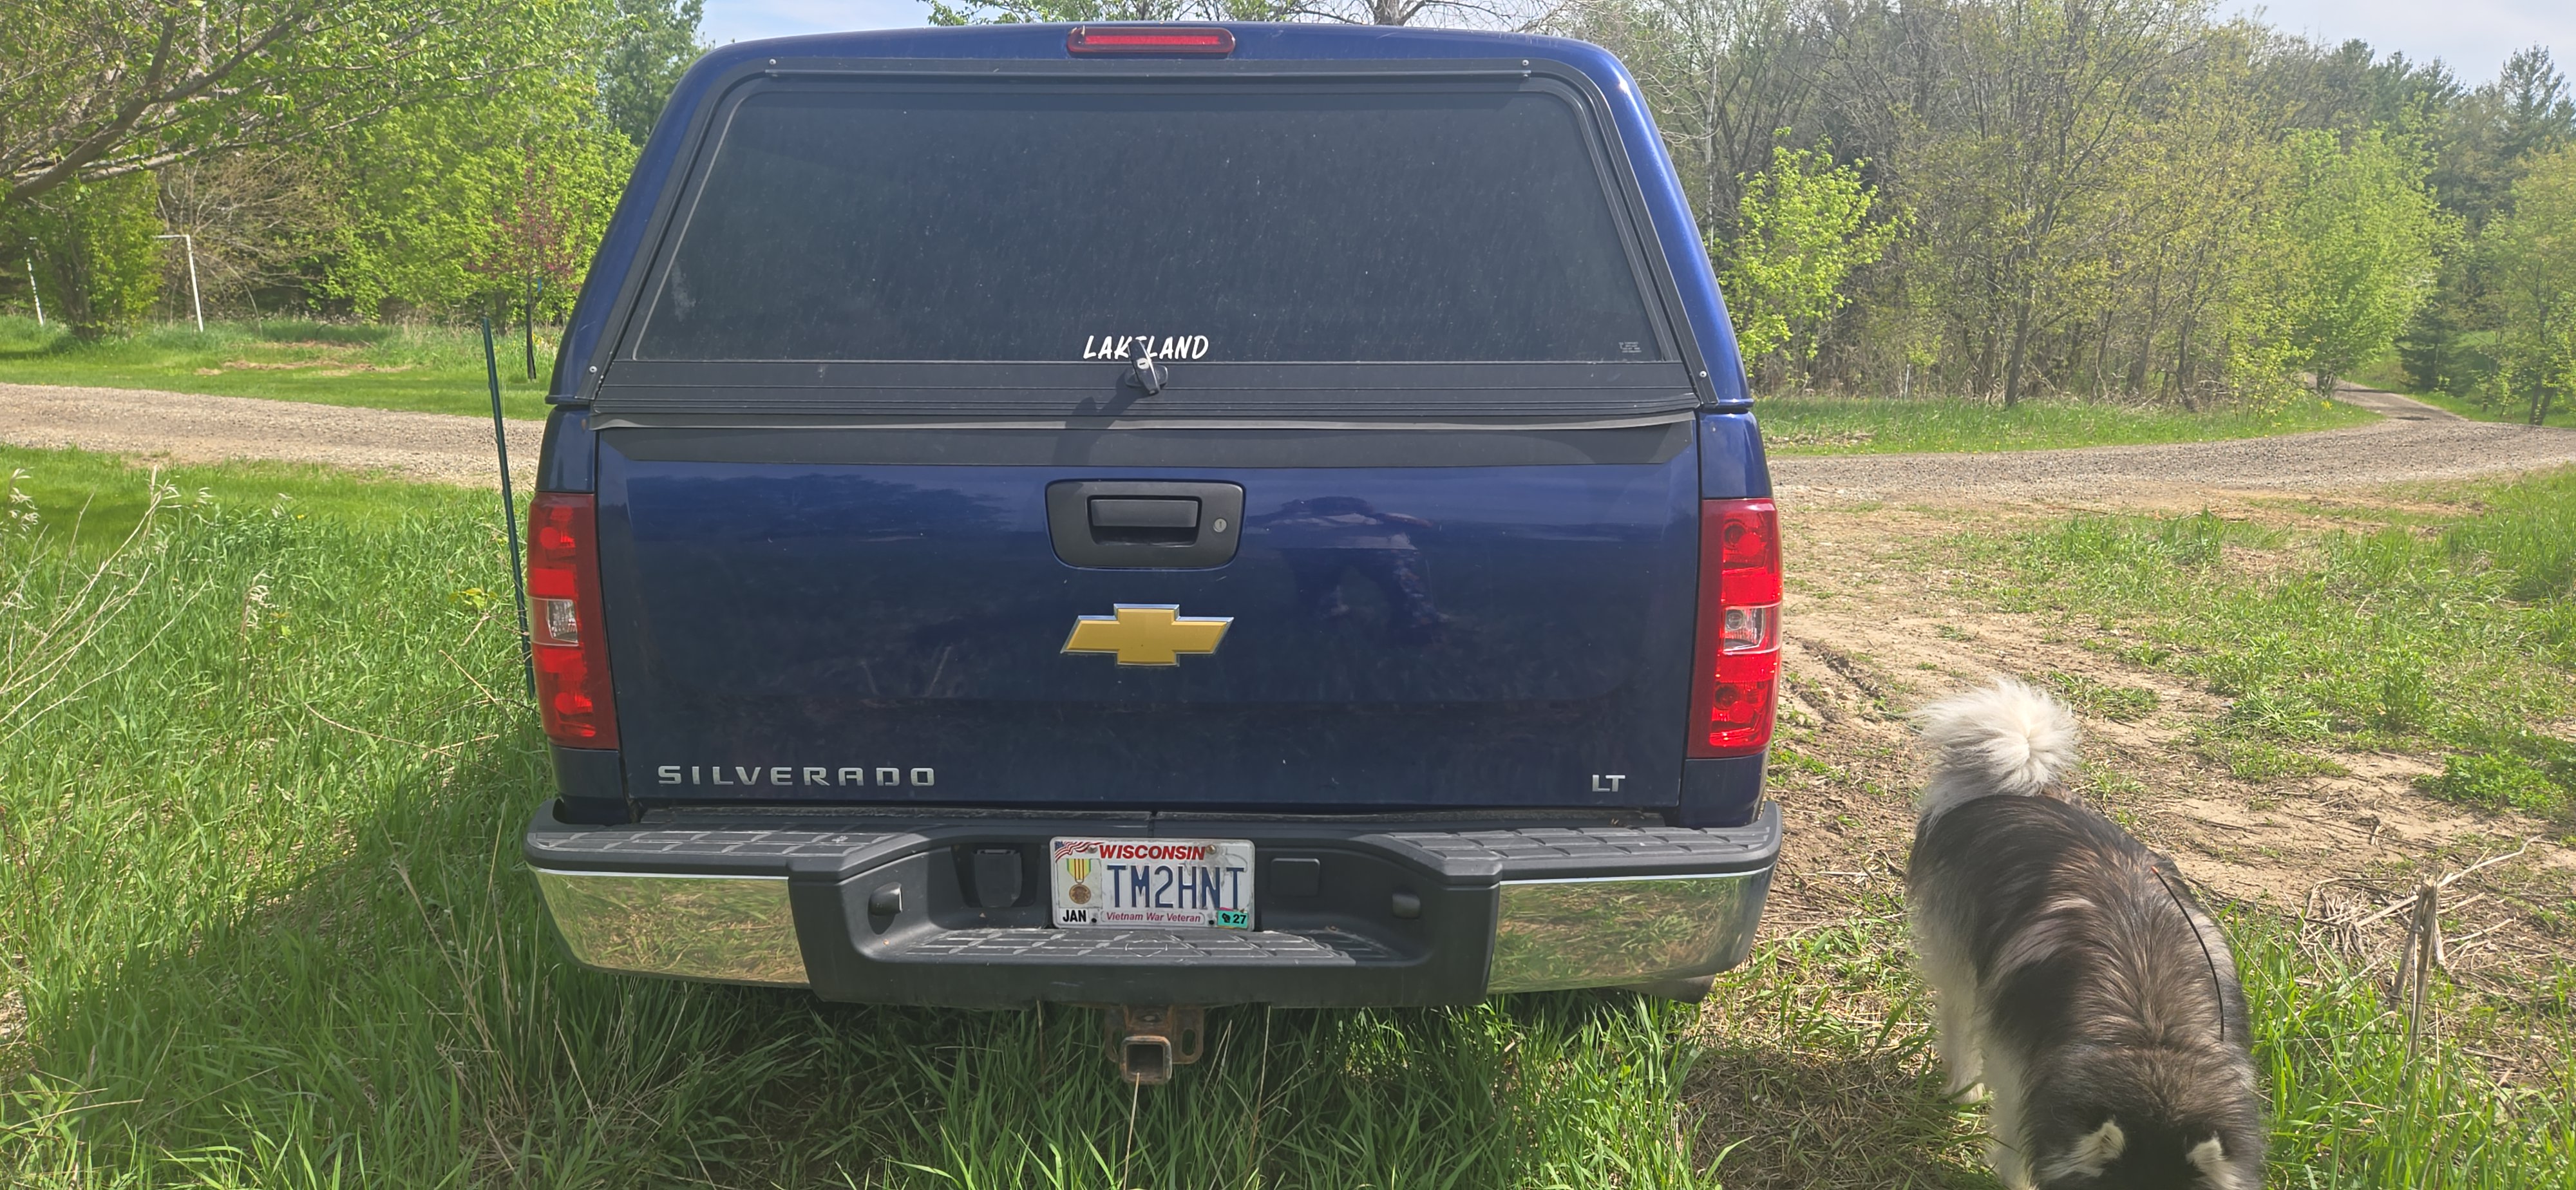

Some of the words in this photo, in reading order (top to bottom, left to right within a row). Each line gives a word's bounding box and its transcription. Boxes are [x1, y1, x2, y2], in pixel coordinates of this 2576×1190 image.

[1083, 335, 1209, 360] LAKLAND
[658, 765, 935, 786] SILVERADO
[1591, 774, 1626, 792] LT
[1099, 844, 1206, 860] WISCONSIN
[1106, 864, 1245, 910] TM2HNT
[1063, 909, 1086, 923] JAN
[1106, 912, 1144, 921] Vietnam
[1146, 912, 1163, 921] War
[1166, 913, 1201, 923] Veteran
[1233, 914, 1247, 925] 27
